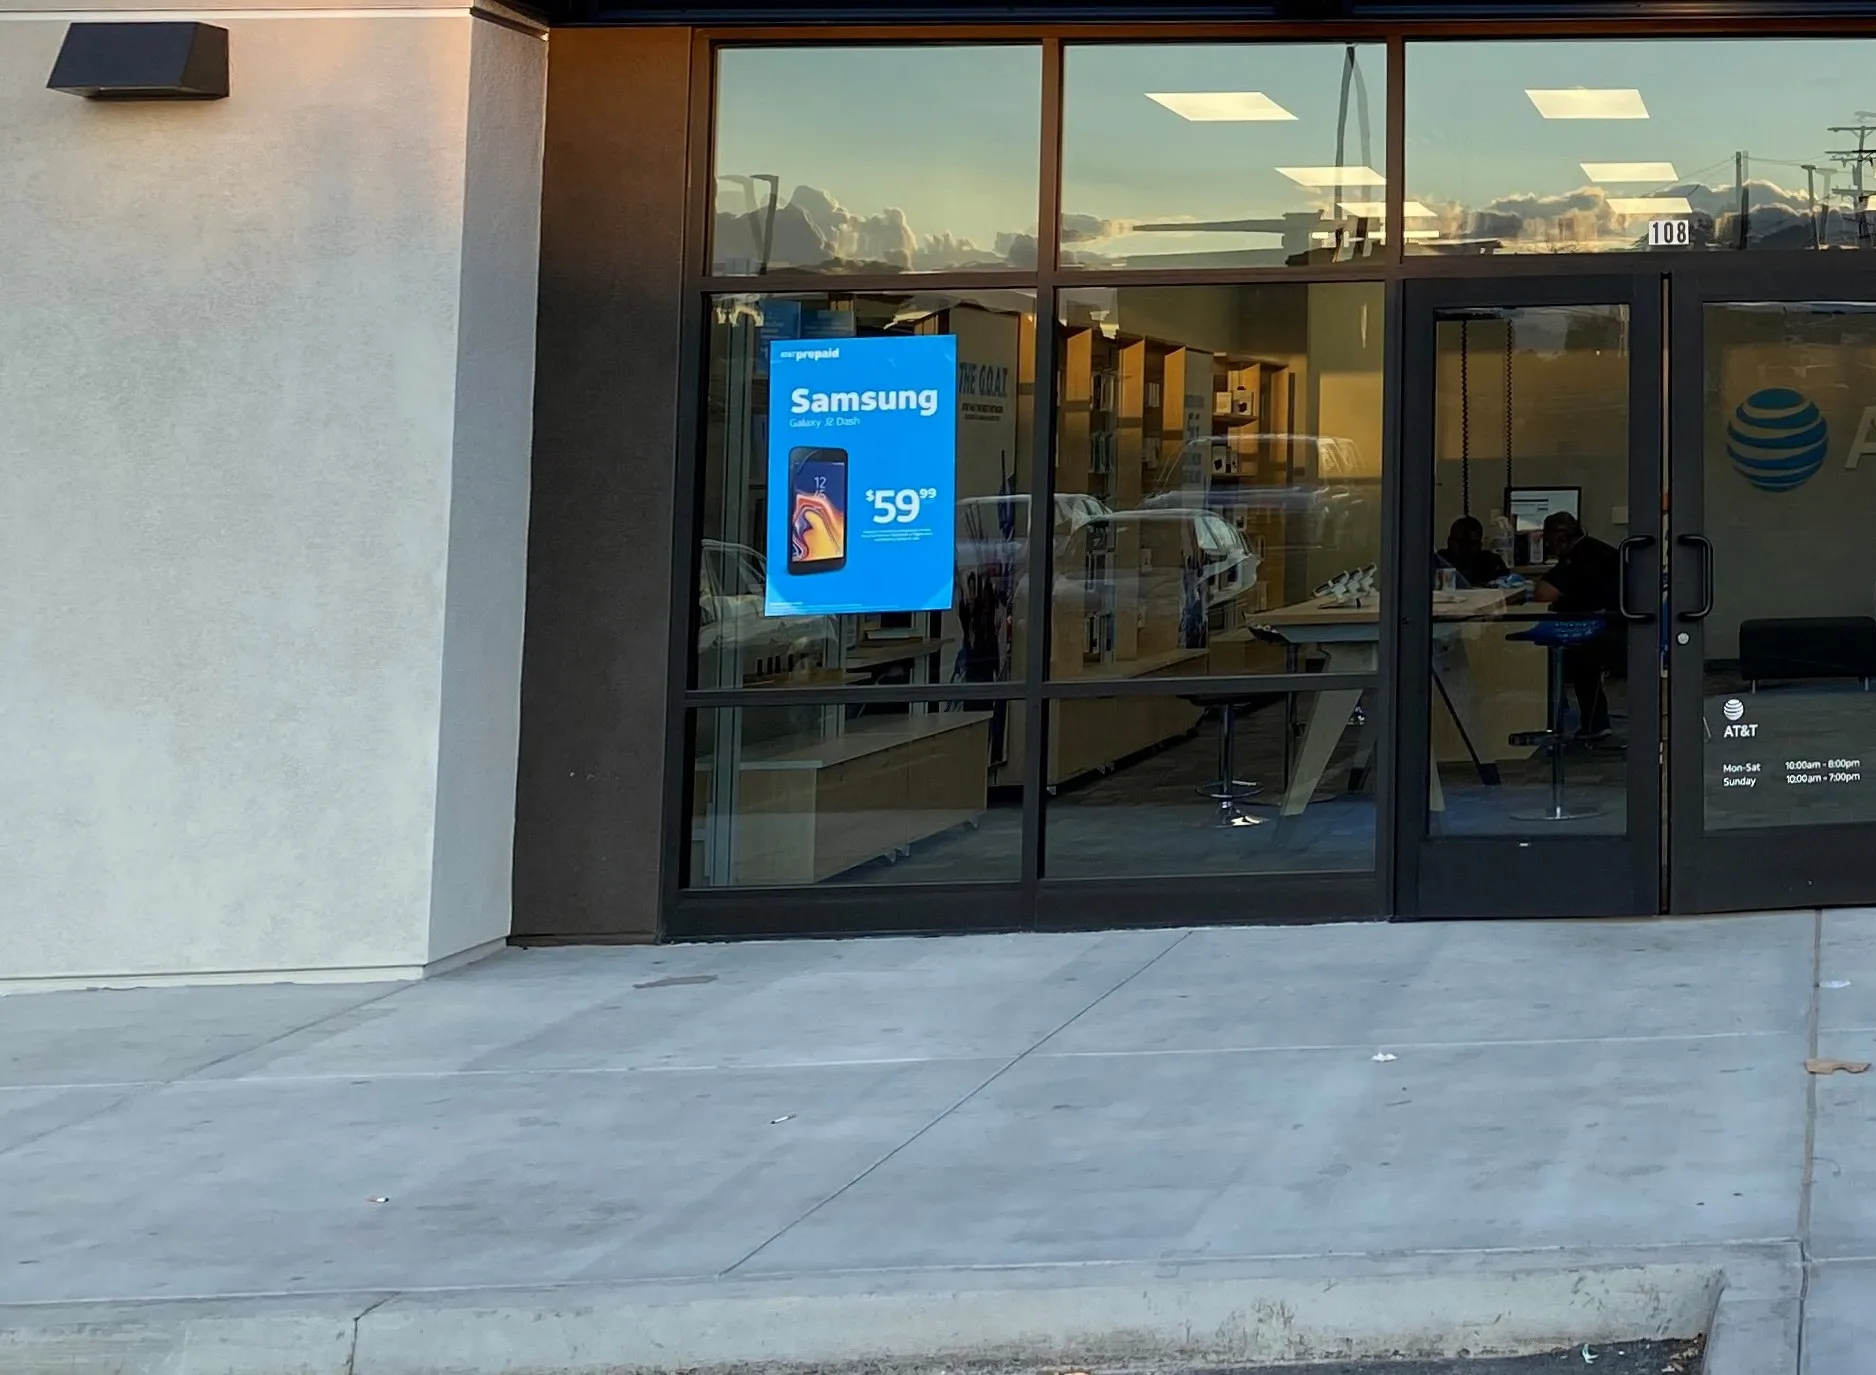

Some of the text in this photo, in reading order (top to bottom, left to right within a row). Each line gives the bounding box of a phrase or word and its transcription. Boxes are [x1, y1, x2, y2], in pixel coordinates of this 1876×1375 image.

[1652, 221, 1687, 244] 108
[795, 347, 840, 362] prepaid
[790, 387, 939, 417] Samsung
[789, 417, 822, 429] Galaxy
[836, 416, 861, 426] Dash
[814, 476, 827, 489] 12
[1723, 723, 1759, 738] AT&T
[1722, 762, 1762, 773] Mon-Sat
[1785, 760, 1821, 771] 10:00am
[1723, 776, 1757, 788] Sunday
[1786, 774, 1822, 785] 10:00am
[1829, 772, 1861, 783] 7:00pm
